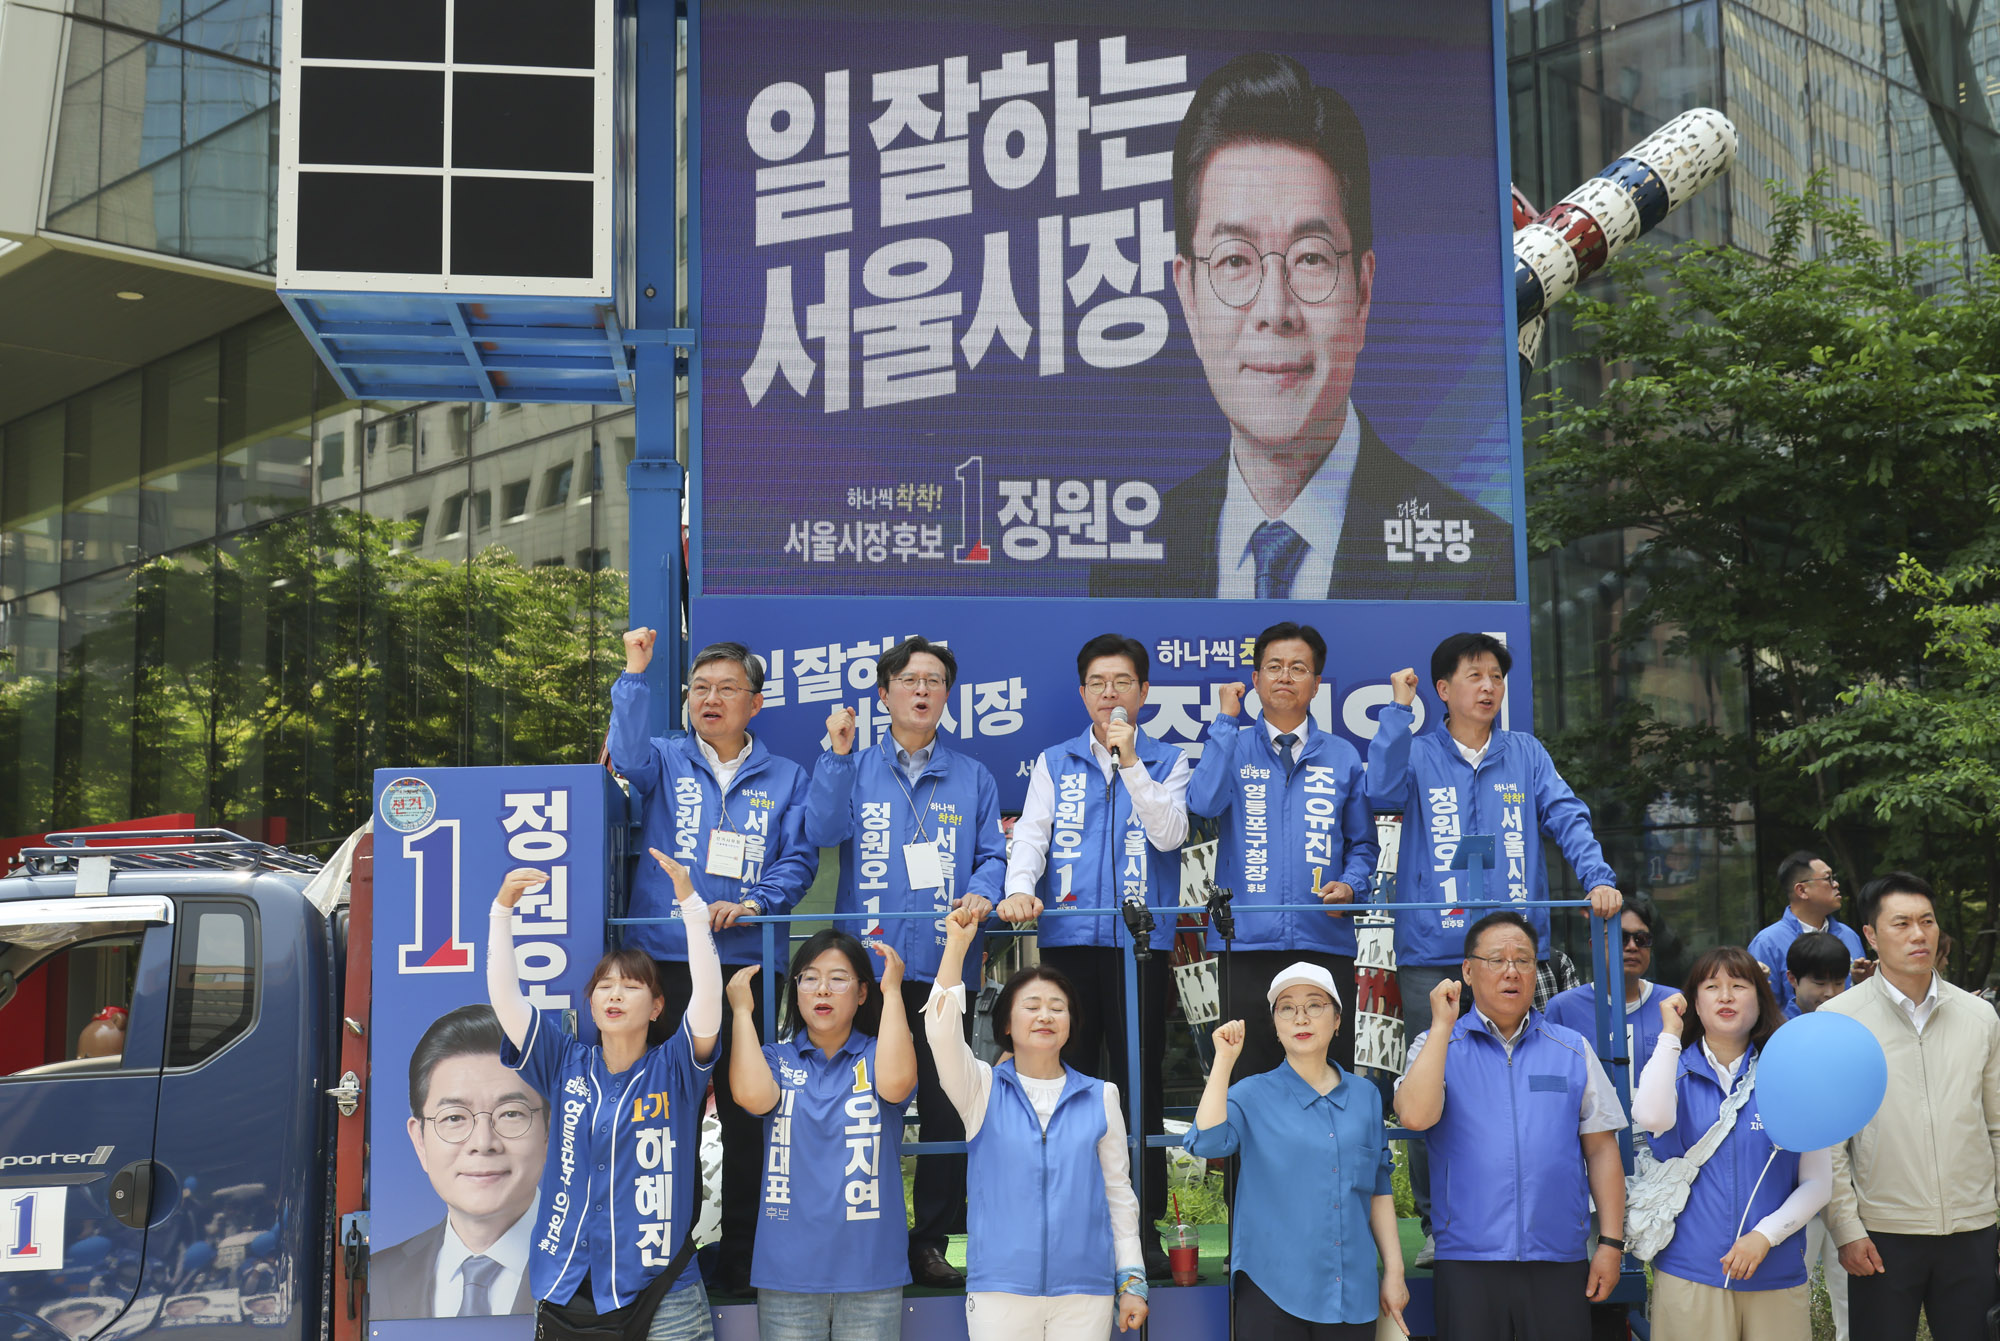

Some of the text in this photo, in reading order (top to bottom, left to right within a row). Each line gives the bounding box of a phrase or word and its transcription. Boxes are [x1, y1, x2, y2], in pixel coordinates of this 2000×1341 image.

[746, 35, 1196, 246] 일 잘하는
[741, 199, 1177, 413] 서울시장
[847, 483, 943, 512] 하나씩 착착!
[953, 456, 991, 564] 1
[998, 479, 1163, 561] 정원오
[1384, 519, 1474, 563] 민주당
[1157, 639, 1236, 668] 하나씩
[741, 789, 768, 799] 하나씩
[750, 797, 775, 810] 착착!
[930, 803, 956, 813] 하나씩
[1240, 768, 1270, 780] 민주당
[1494, 784, 1517, 792] 하나씩
[1503, 793, 1525, 804] 착착!
[674, 777, 703, 862] 정원오
[938, 812, 963, 825] 착착!
[1053, 773, 1087, 859] 정원오
[1243, 784, 1269, 881] 영등포구청장
[1304, 765, 1336, 894] 조유진 1
[1428, 787, 1464, 916] 정원오 1
[859, 802, 891, 935] 정원오 1
[1055, 864, 1077, 902] 1
[1247, 884, 1267, 893] 후보
[1501, 806, 1528, 909] 서울시장
[398, 819, 475, 974] 1
[502, 790, 571, 1010] 정원오
[631, 1091, 670, 1122] 1-가
[844, 1057, 882, 1221] 1 오지연
[6, 1191, 42, 1259] 1
[634, 1126, 676, 1267] 하혜진
[765, 1206, 789, 1221] 후보
